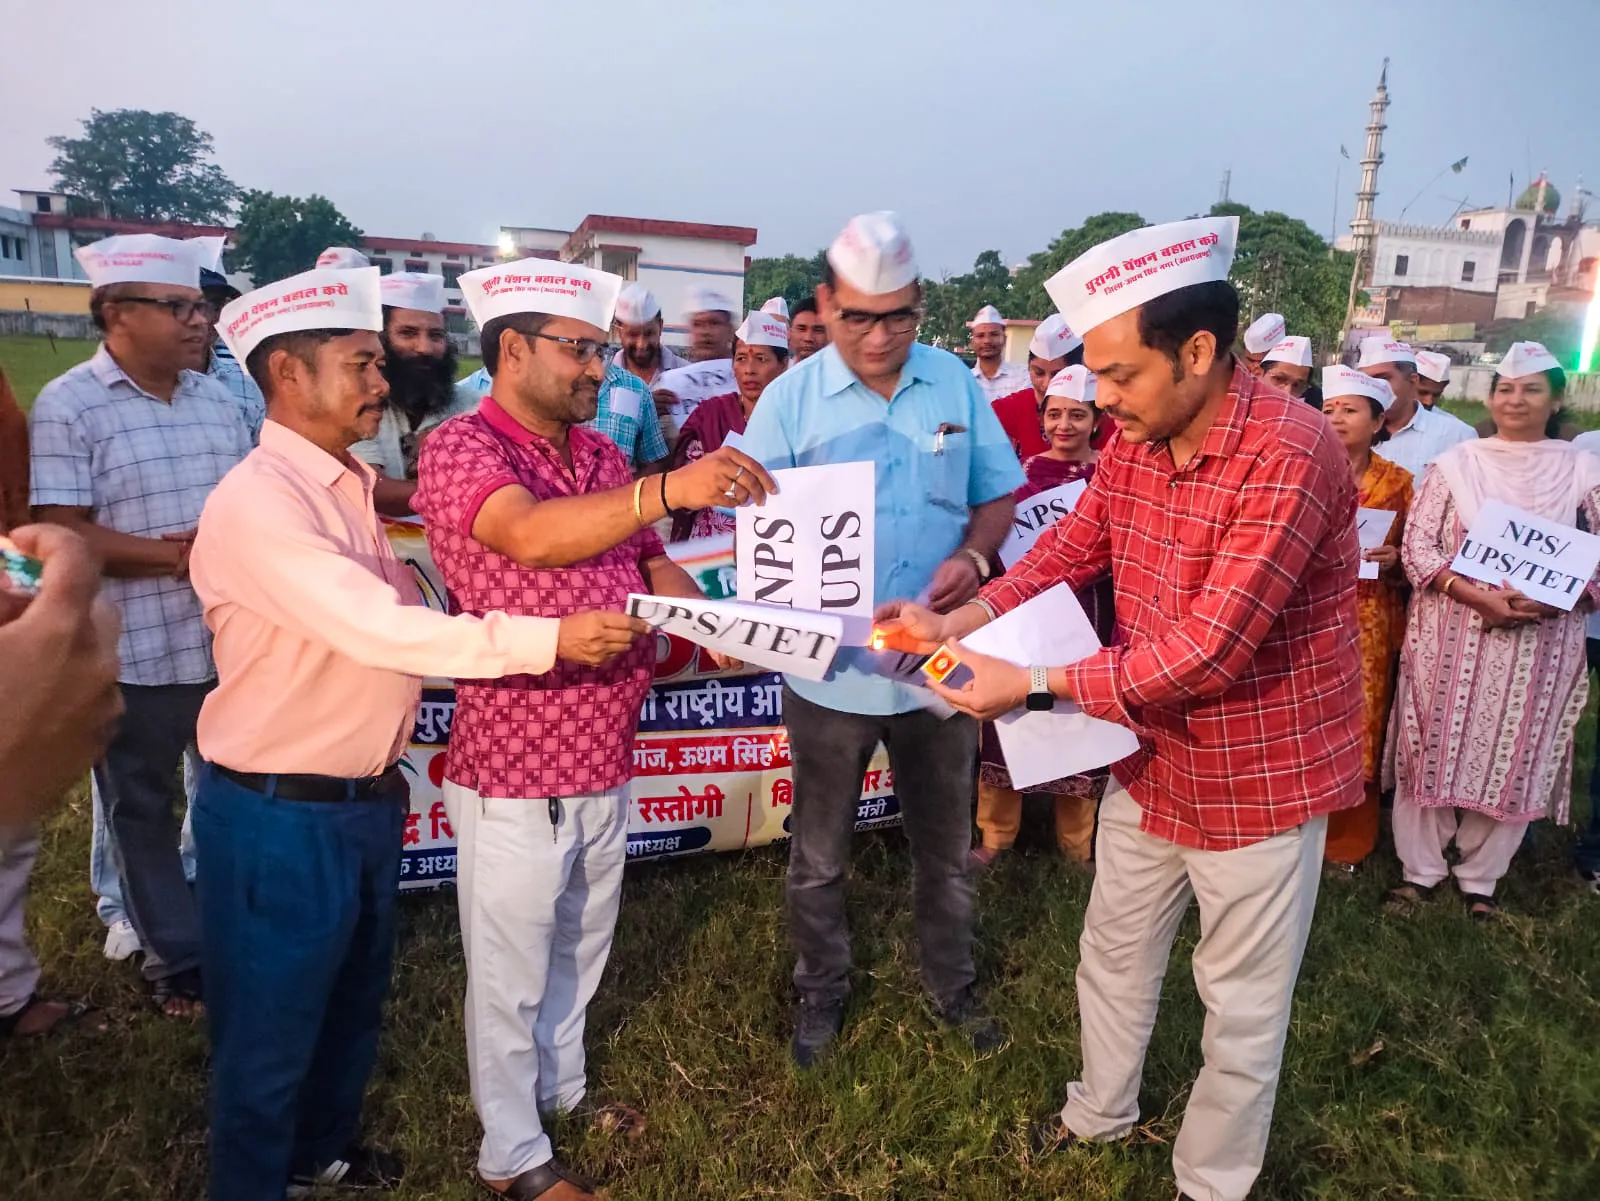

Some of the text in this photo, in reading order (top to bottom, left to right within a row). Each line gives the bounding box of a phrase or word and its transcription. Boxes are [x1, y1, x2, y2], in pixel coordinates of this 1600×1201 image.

[534, 274, 566, 285] बहाल
[1085, 232, 1219, 295] पुरानी पेंशन बहाल करो
[281, 286, 318, 303] बहाल
[321, 282, 348, 296] करो
[1014, 498, 1068, 540] NPS
[1500, 519, 1571, 558] NPS/
[753, 515, 795, 609] NPS
[820, 510, 861, 612] UPS
[1460, 539, 1585, 595] UPS/TET
[631, 598, 837, 660] UPS/TET
[416, 702, 456, 742] पुर
[664, 679, 745, 727] राष्ट्रीय
[633, 742, 674, 772] गंज,
[679, 745, 727, 767] ऊधम
[732, 737, 773, 767] सिंह
[637, 783, 725, 824] रस्तोगी
[416, 854, 457, 875] अध्य
